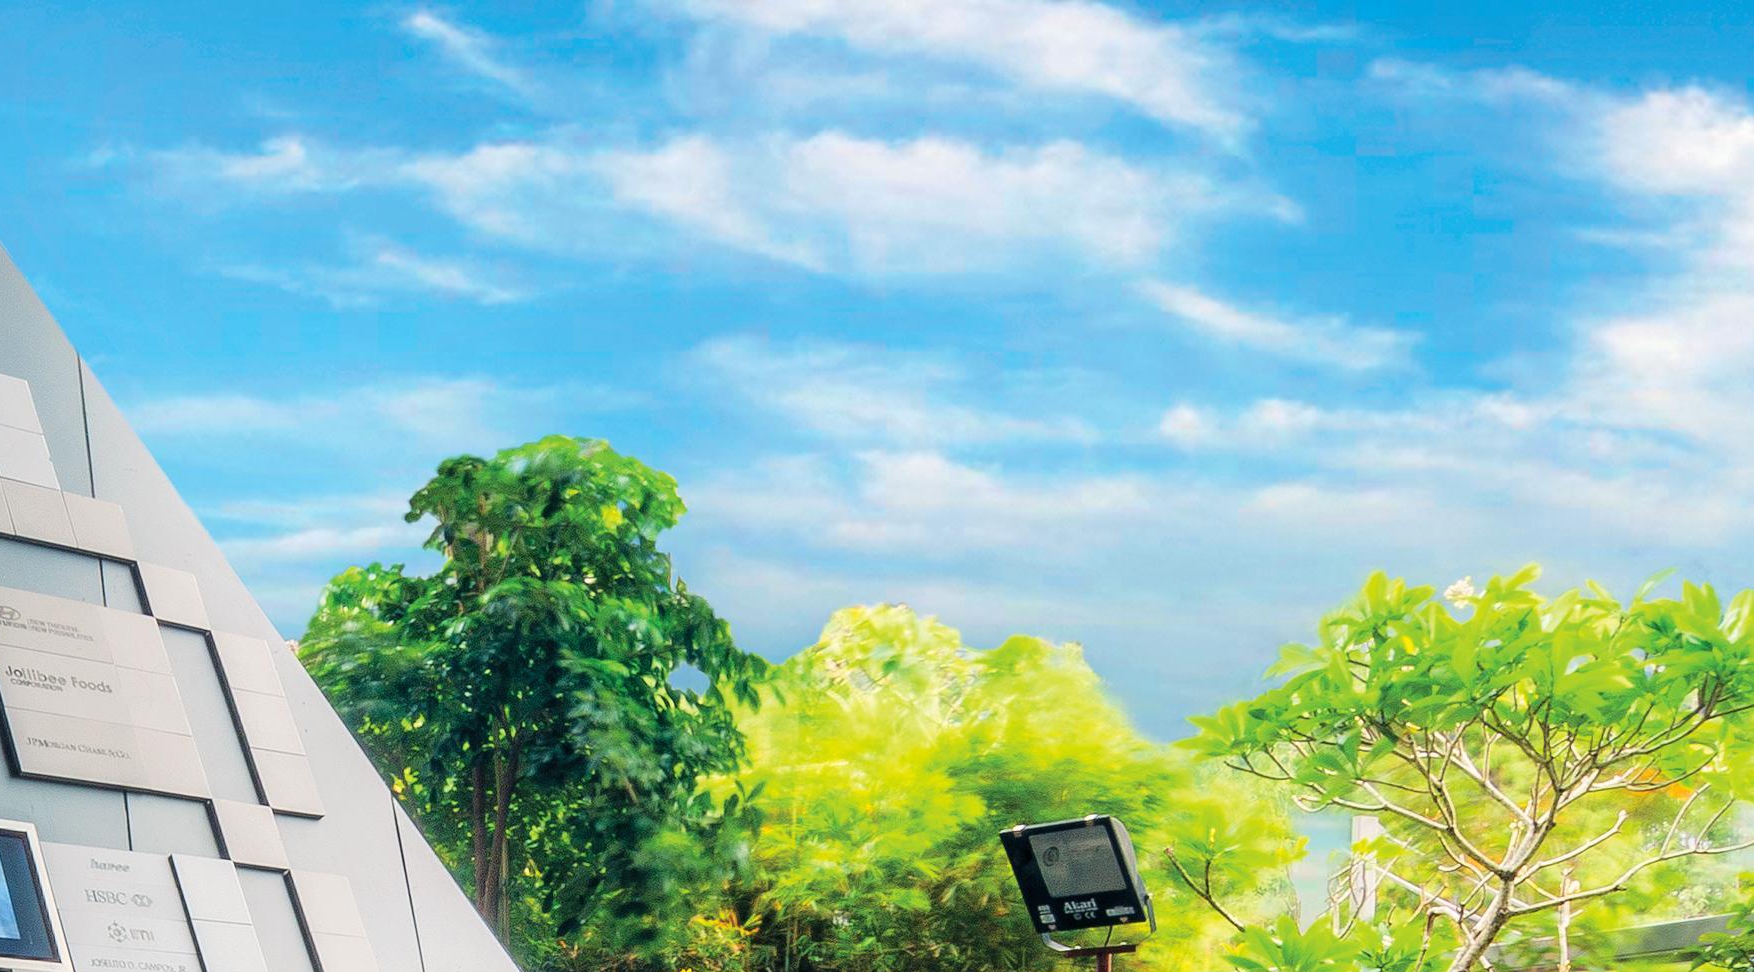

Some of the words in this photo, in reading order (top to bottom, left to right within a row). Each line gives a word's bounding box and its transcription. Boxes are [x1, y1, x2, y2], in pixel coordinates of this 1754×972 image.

[5, 665, 67, 686] Jollibee
[71, 675, 113, 693] Foods
[85, 889, 128, 905] HSBC
[1064, 898, 1097, 913] Akari
